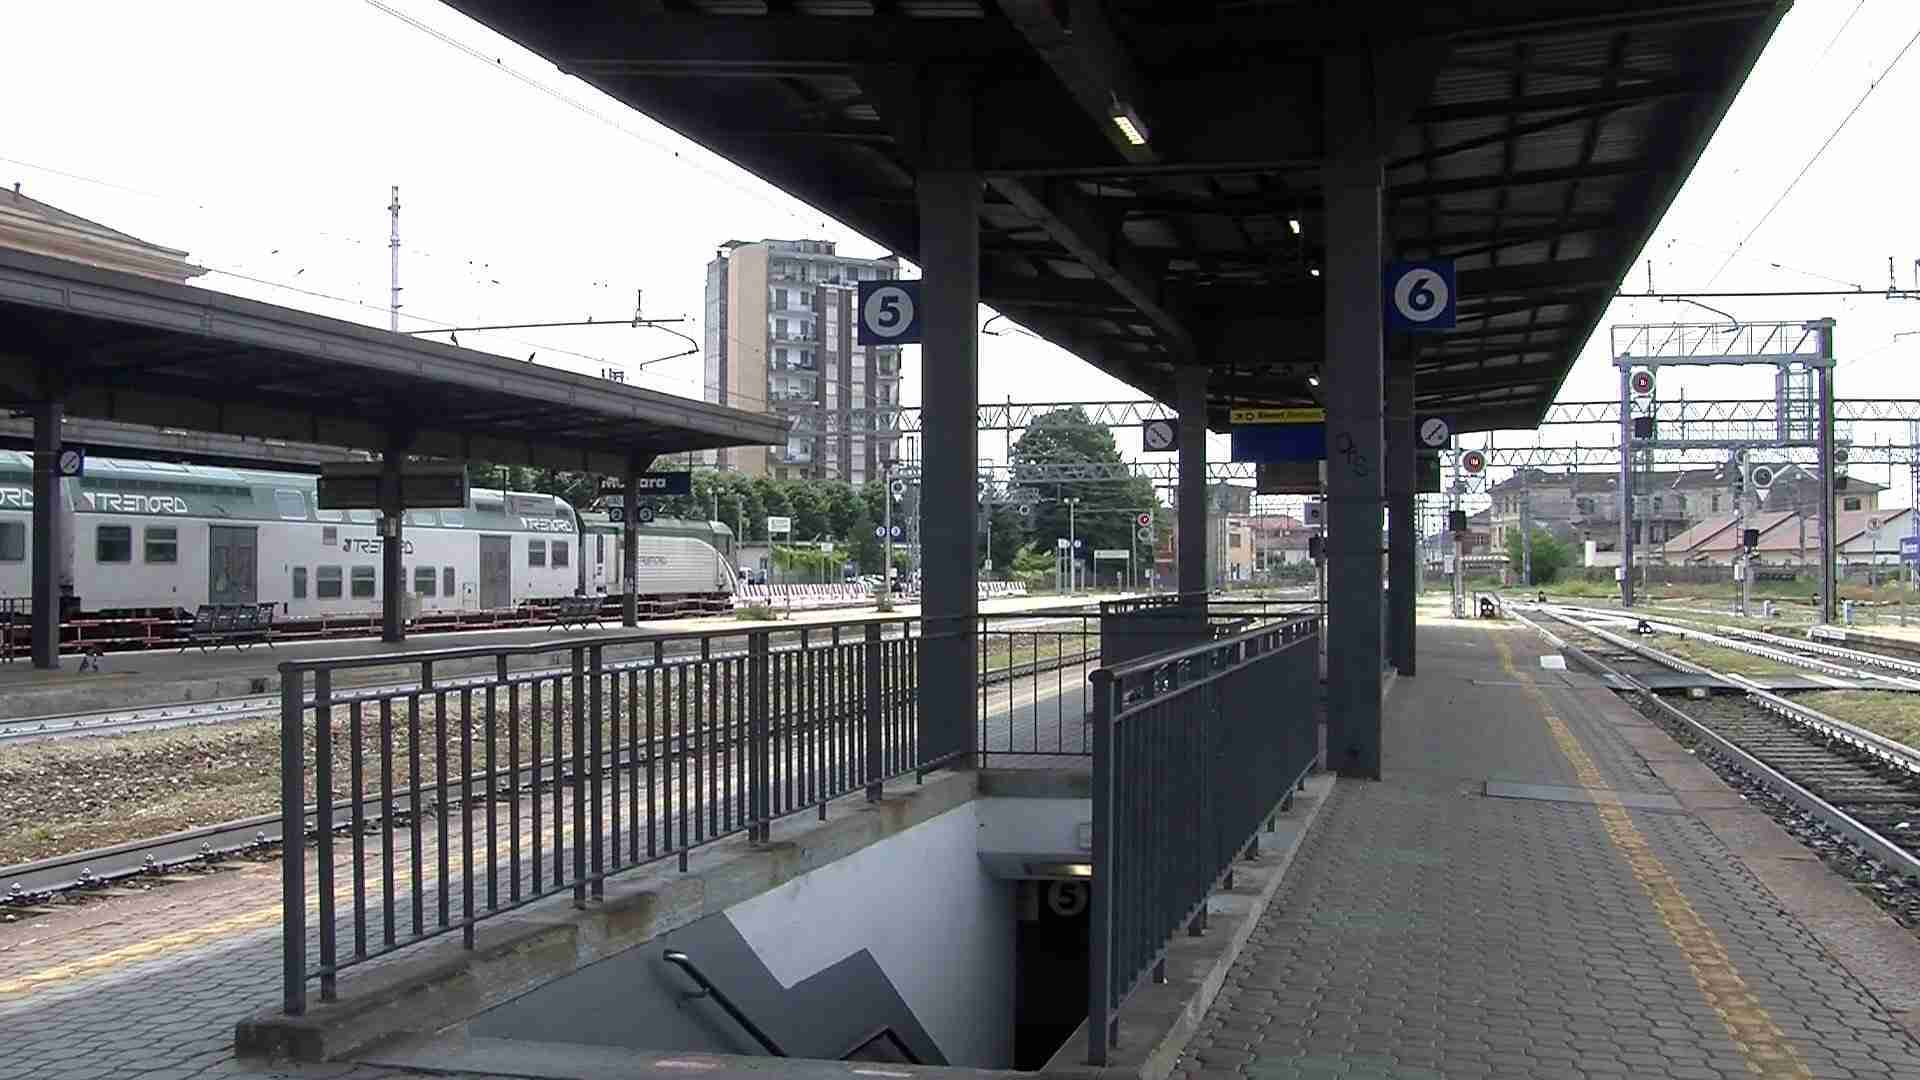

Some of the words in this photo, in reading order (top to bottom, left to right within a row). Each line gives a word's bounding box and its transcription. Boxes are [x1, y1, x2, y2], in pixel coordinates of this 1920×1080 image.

[1408, 277, 1435, 310] 6
[878, 296, 900, 327] 5
[96, 492, 188, 513] TRENORD
[1058, 885, 1076, 908] 5
